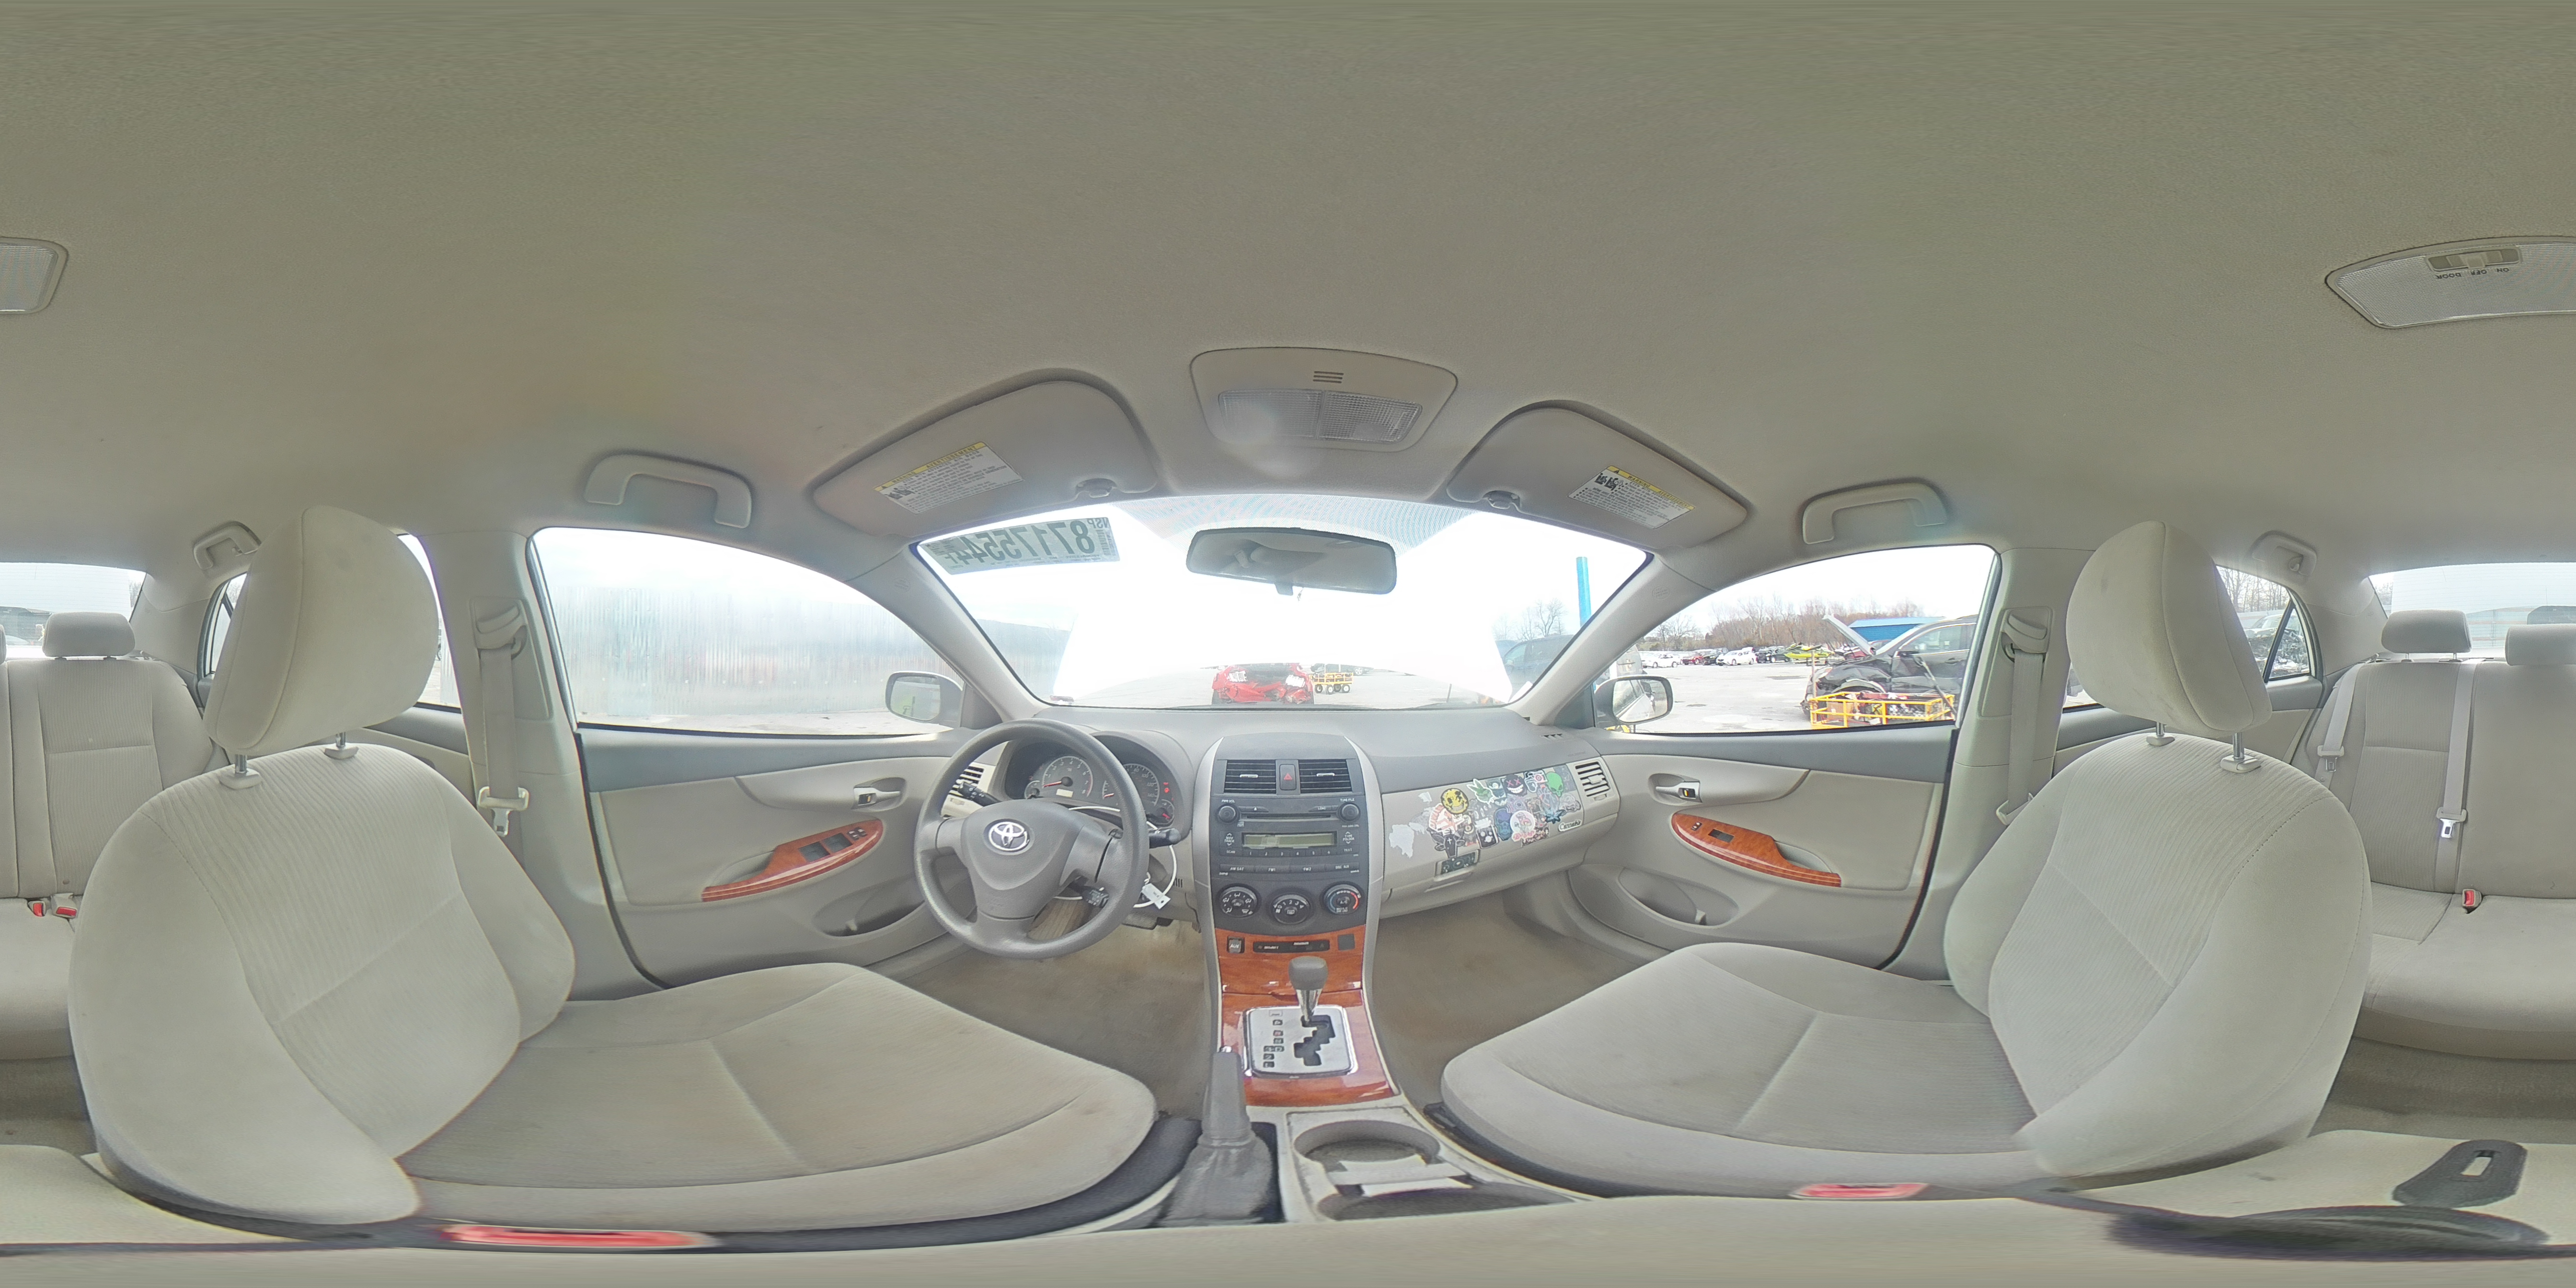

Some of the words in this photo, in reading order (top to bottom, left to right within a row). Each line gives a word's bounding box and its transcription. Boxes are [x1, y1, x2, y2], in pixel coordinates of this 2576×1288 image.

[892, 472, 916, 483] WARNING
[926, 446, 977, 468] AVERTISSEMENT
[1628, 475, 1651, 488] WARNING
